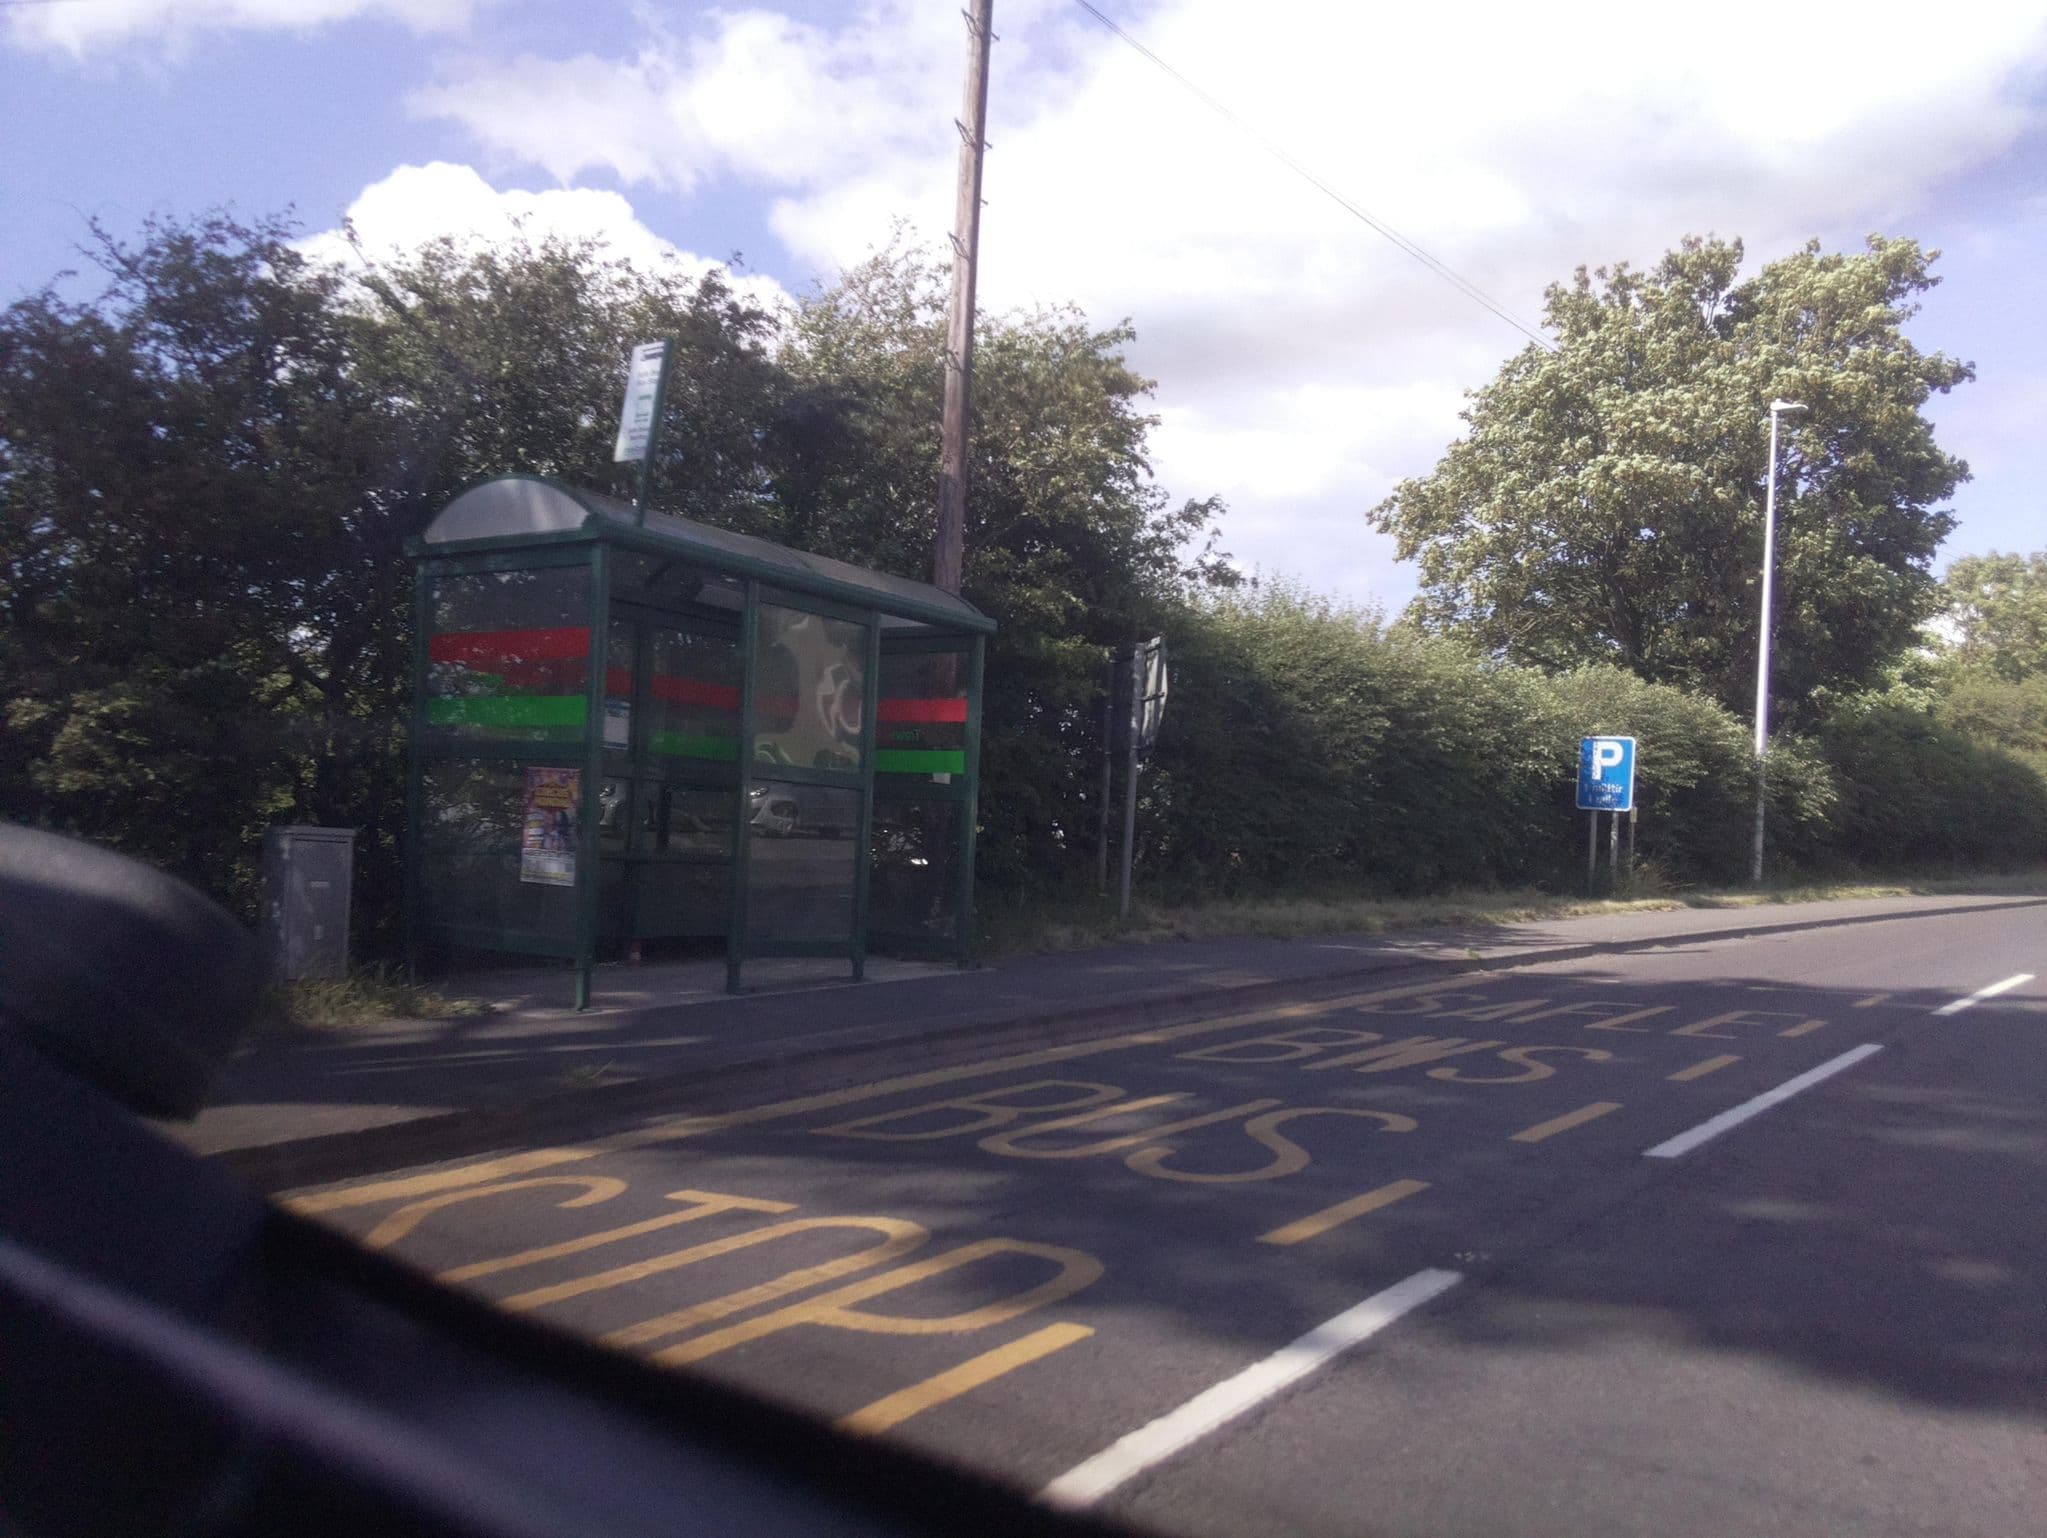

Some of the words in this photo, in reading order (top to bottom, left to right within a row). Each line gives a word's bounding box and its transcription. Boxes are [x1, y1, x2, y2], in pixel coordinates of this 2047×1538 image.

[1591, 741, 1624, 780] P
[1357, 993, 1807, 1039] SAFLE
[1175, 1027, 1612, 1084] BWS
[810, 1079, 1418, 1183] BUS
